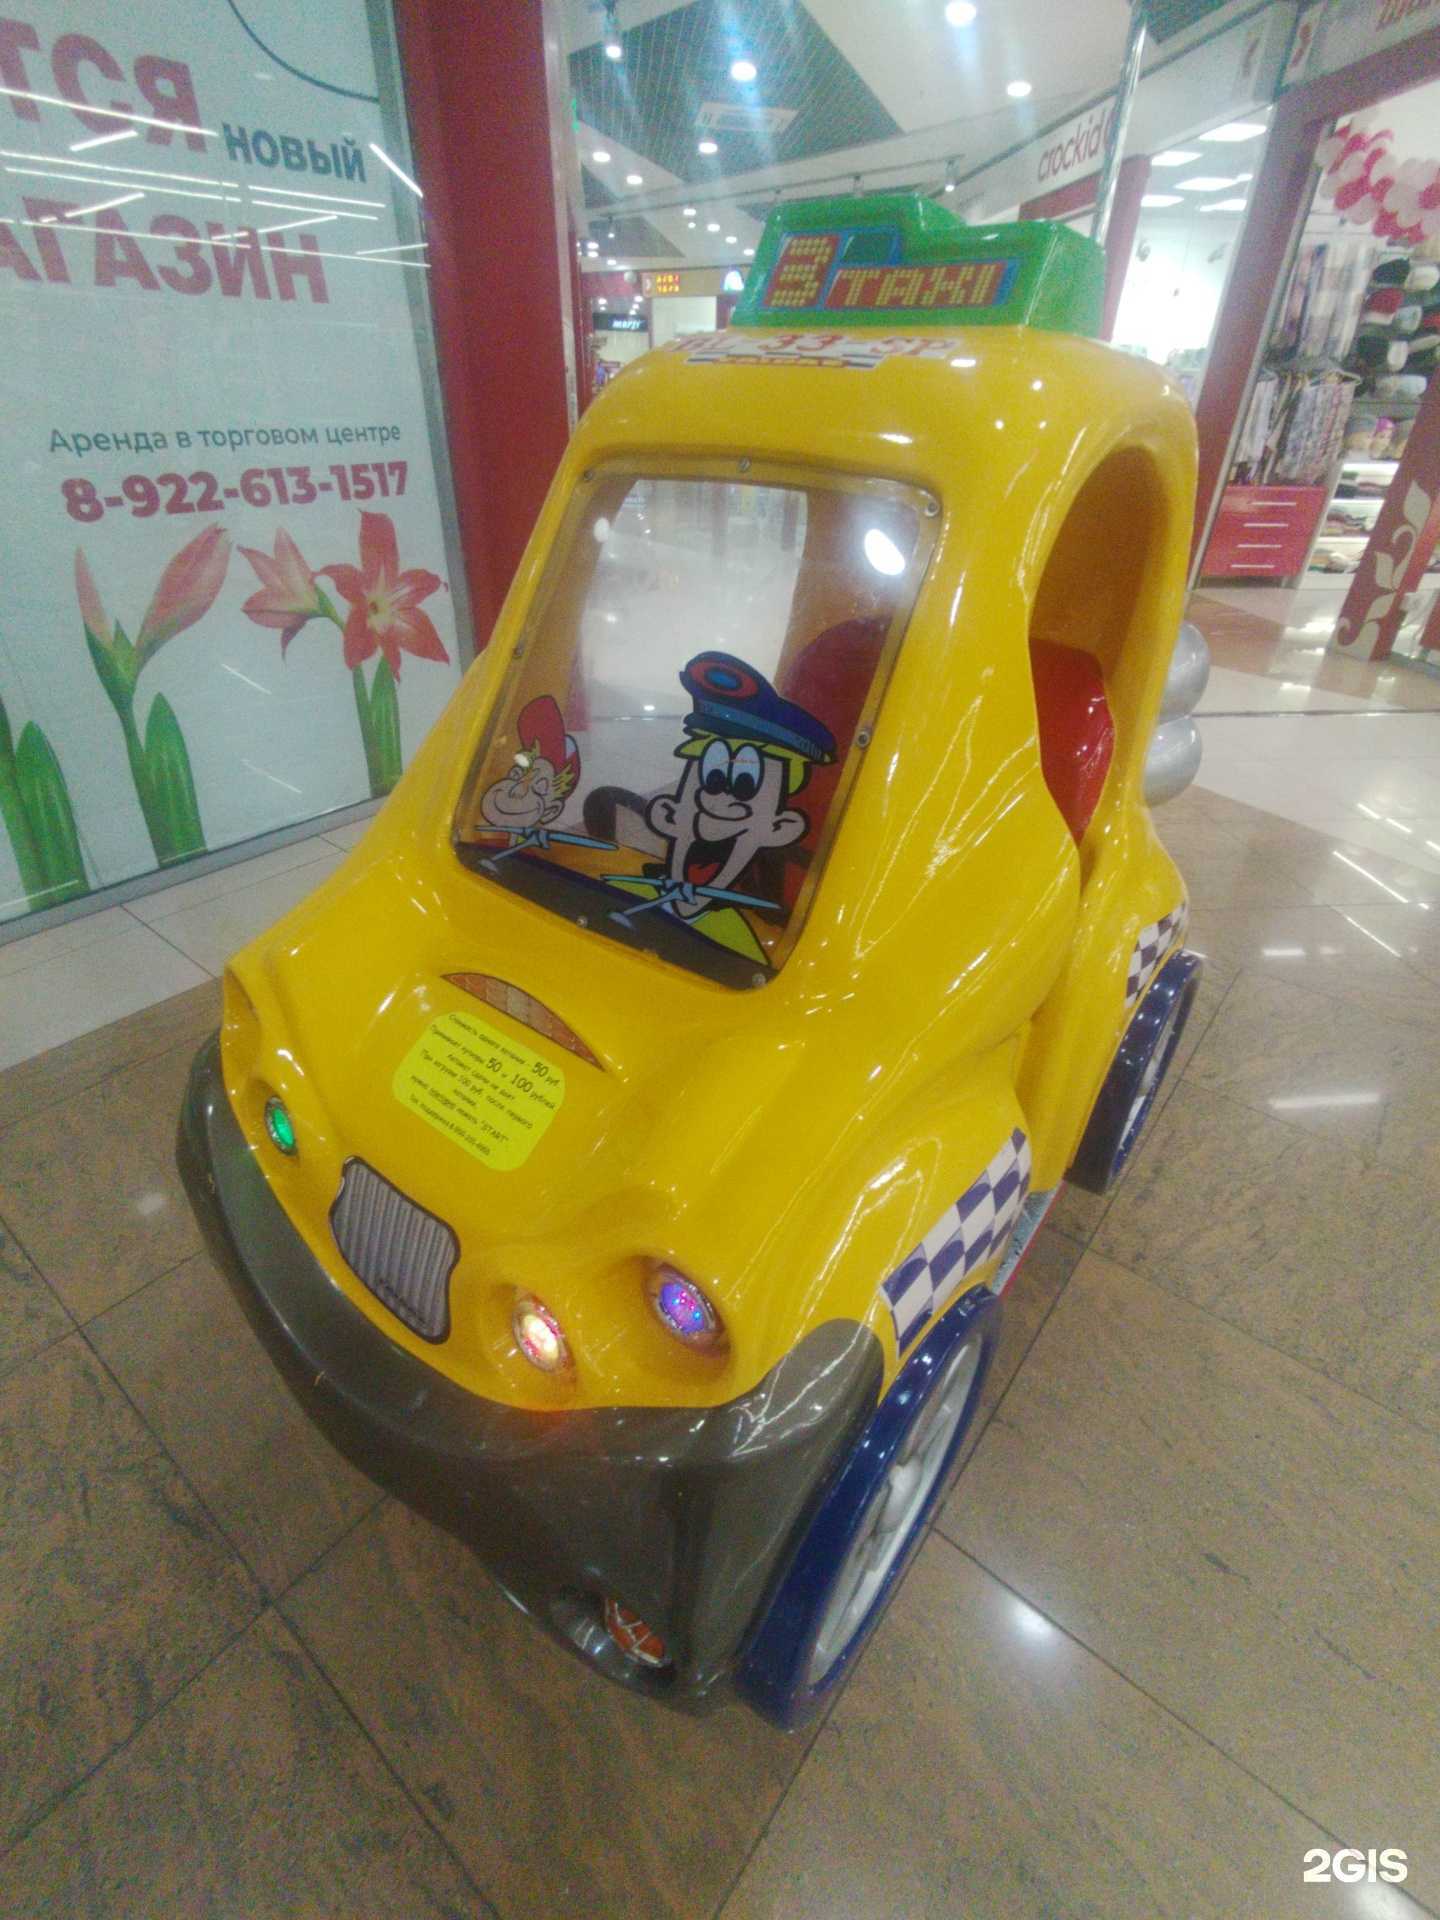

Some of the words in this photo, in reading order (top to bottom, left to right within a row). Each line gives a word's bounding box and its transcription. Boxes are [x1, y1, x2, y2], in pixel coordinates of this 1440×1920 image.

[222, 122, 366, 183] НОВЫЙ
[50, 428, 168, 457] Аренда
[177, 429, 192, 448] в
[197, 425, 319, 453] торговом
[326, 424, 402, 445] центре
[61, 461, 408, 523] 8-922-613-1517
[485, 1056, 503, 1074] 50
[510, 1072, 534, 1094] 100
[531, 1060, 550, 1079] 50
